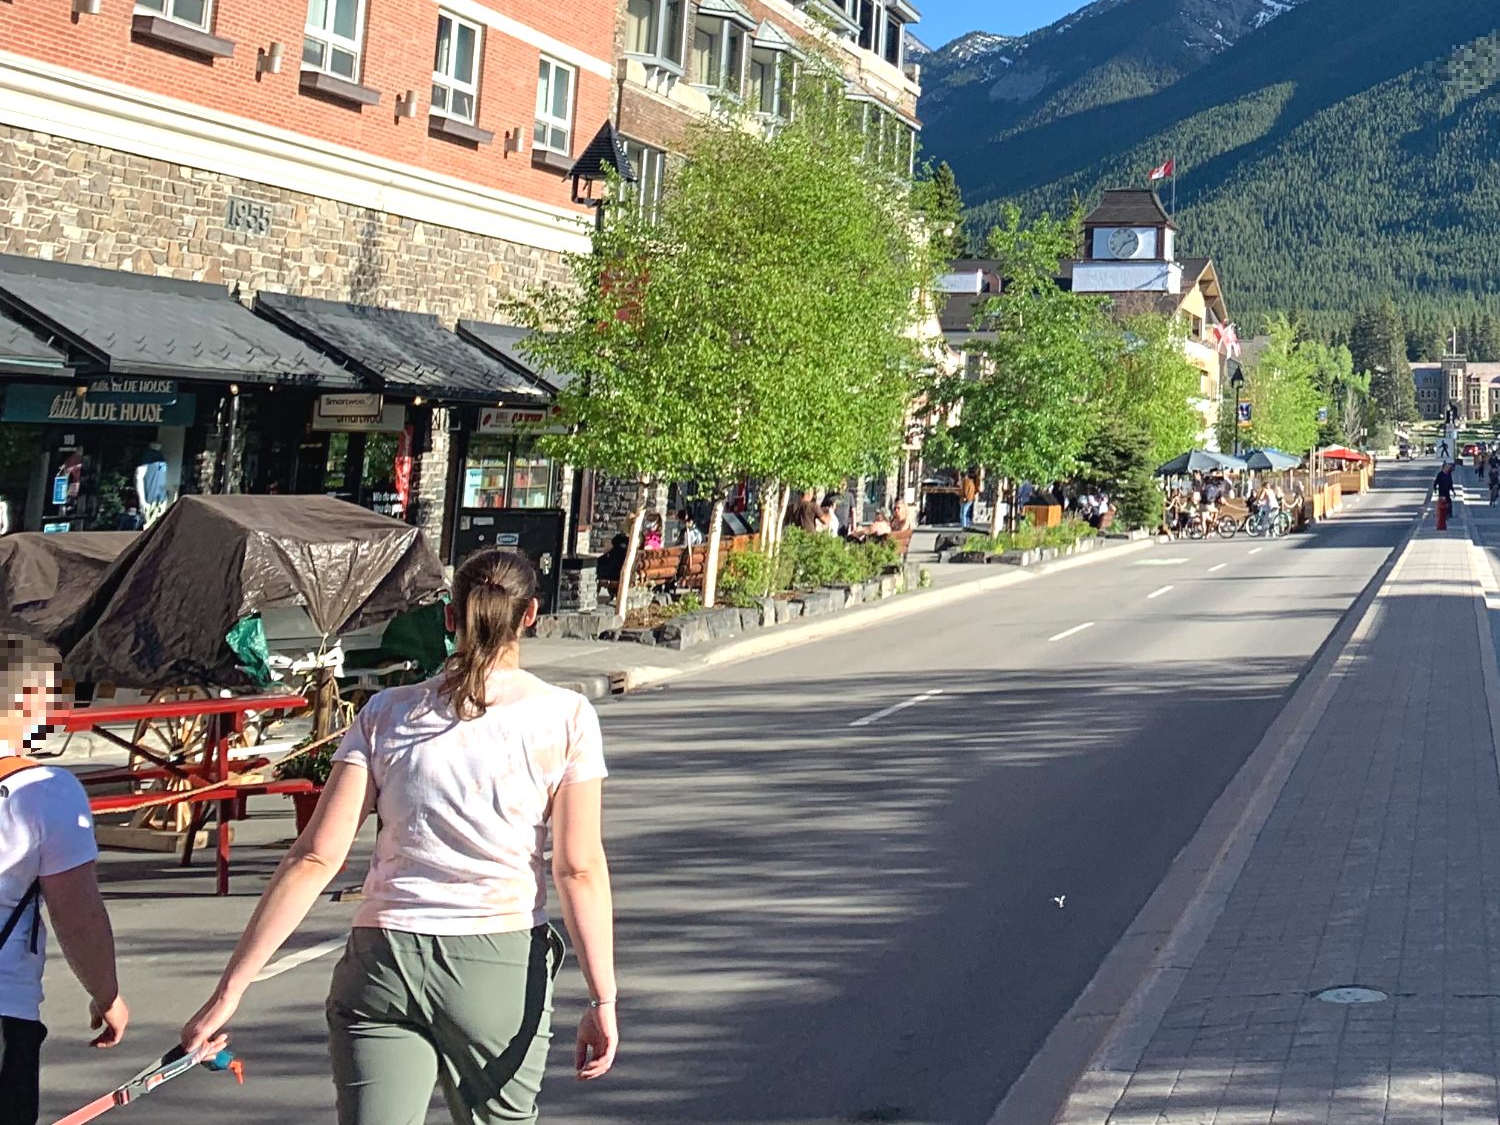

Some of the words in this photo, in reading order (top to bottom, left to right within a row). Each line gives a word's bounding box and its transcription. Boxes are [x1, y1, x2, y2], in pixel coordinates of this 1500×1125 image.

[229, 199, 272, 235] 1955
[139, 380, 173, 393] HOUSE
[48, 390, 80, 418] little
[81, 401, 117, 421] BLUE
[120, 402, 163, 422] HOUSE
